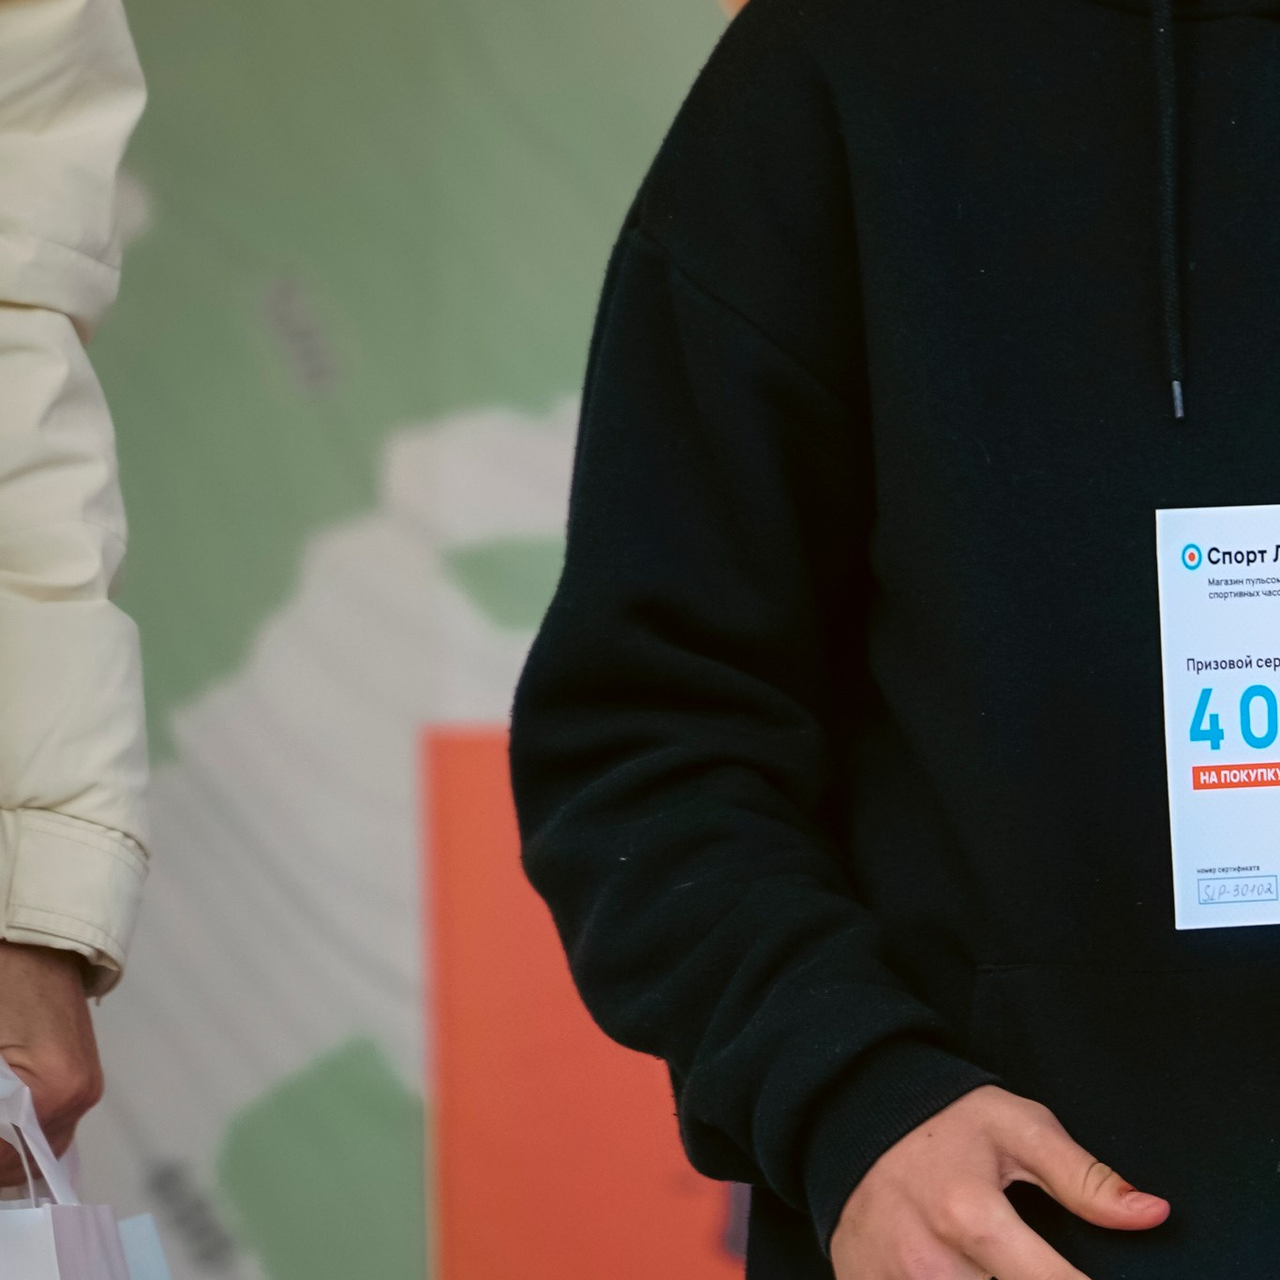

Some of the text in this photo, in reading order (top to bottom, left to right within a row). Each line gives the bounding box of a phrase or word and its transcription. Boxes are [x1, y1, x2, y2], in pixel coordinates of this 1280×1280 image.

[1207, 547, 1267, 566] Спорт
[1208, 577, 1244, 587] Магазин
[1208, 589, 1260, 601] спортивных
[1186, 655, 1252, 675] Призовой
[1200, 771, 1218, 785] НА
